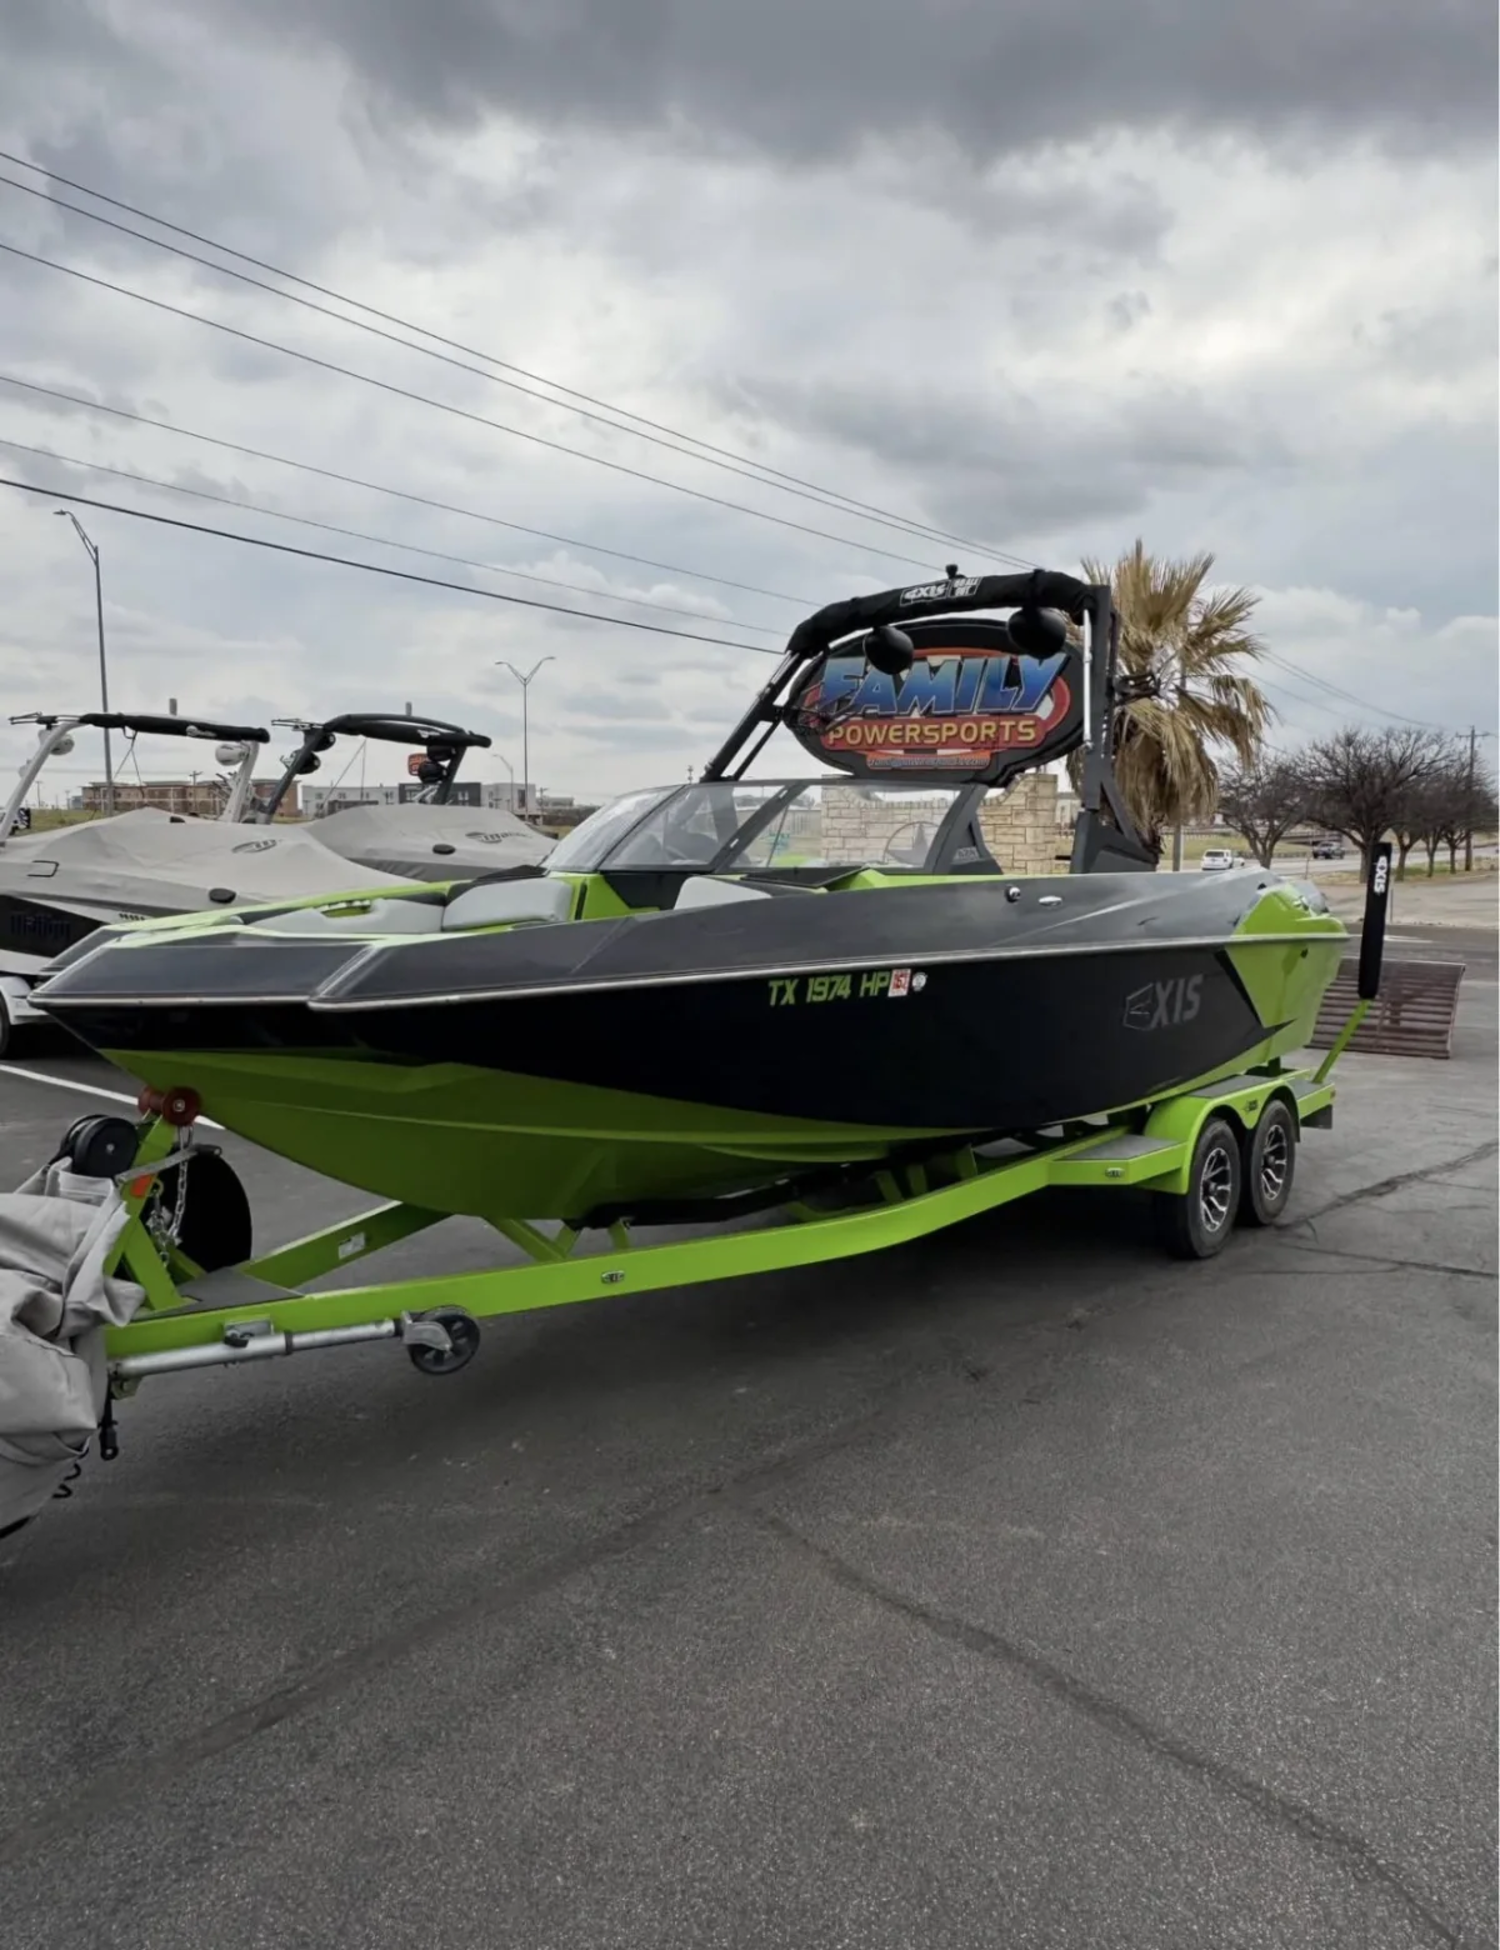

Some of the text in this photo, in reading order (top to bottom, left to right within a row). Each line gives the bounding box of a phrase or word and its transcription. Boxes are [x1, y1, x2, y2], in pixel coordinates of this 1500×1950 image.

[818, 654, 1070, 715] FAMILY
[828, 719, 1036, 746] POWERSPORTS
[768, 978, 799, 1007] TX
[805, 973, 852, 1003] 1974
[859, 971, 890, 998] HP
